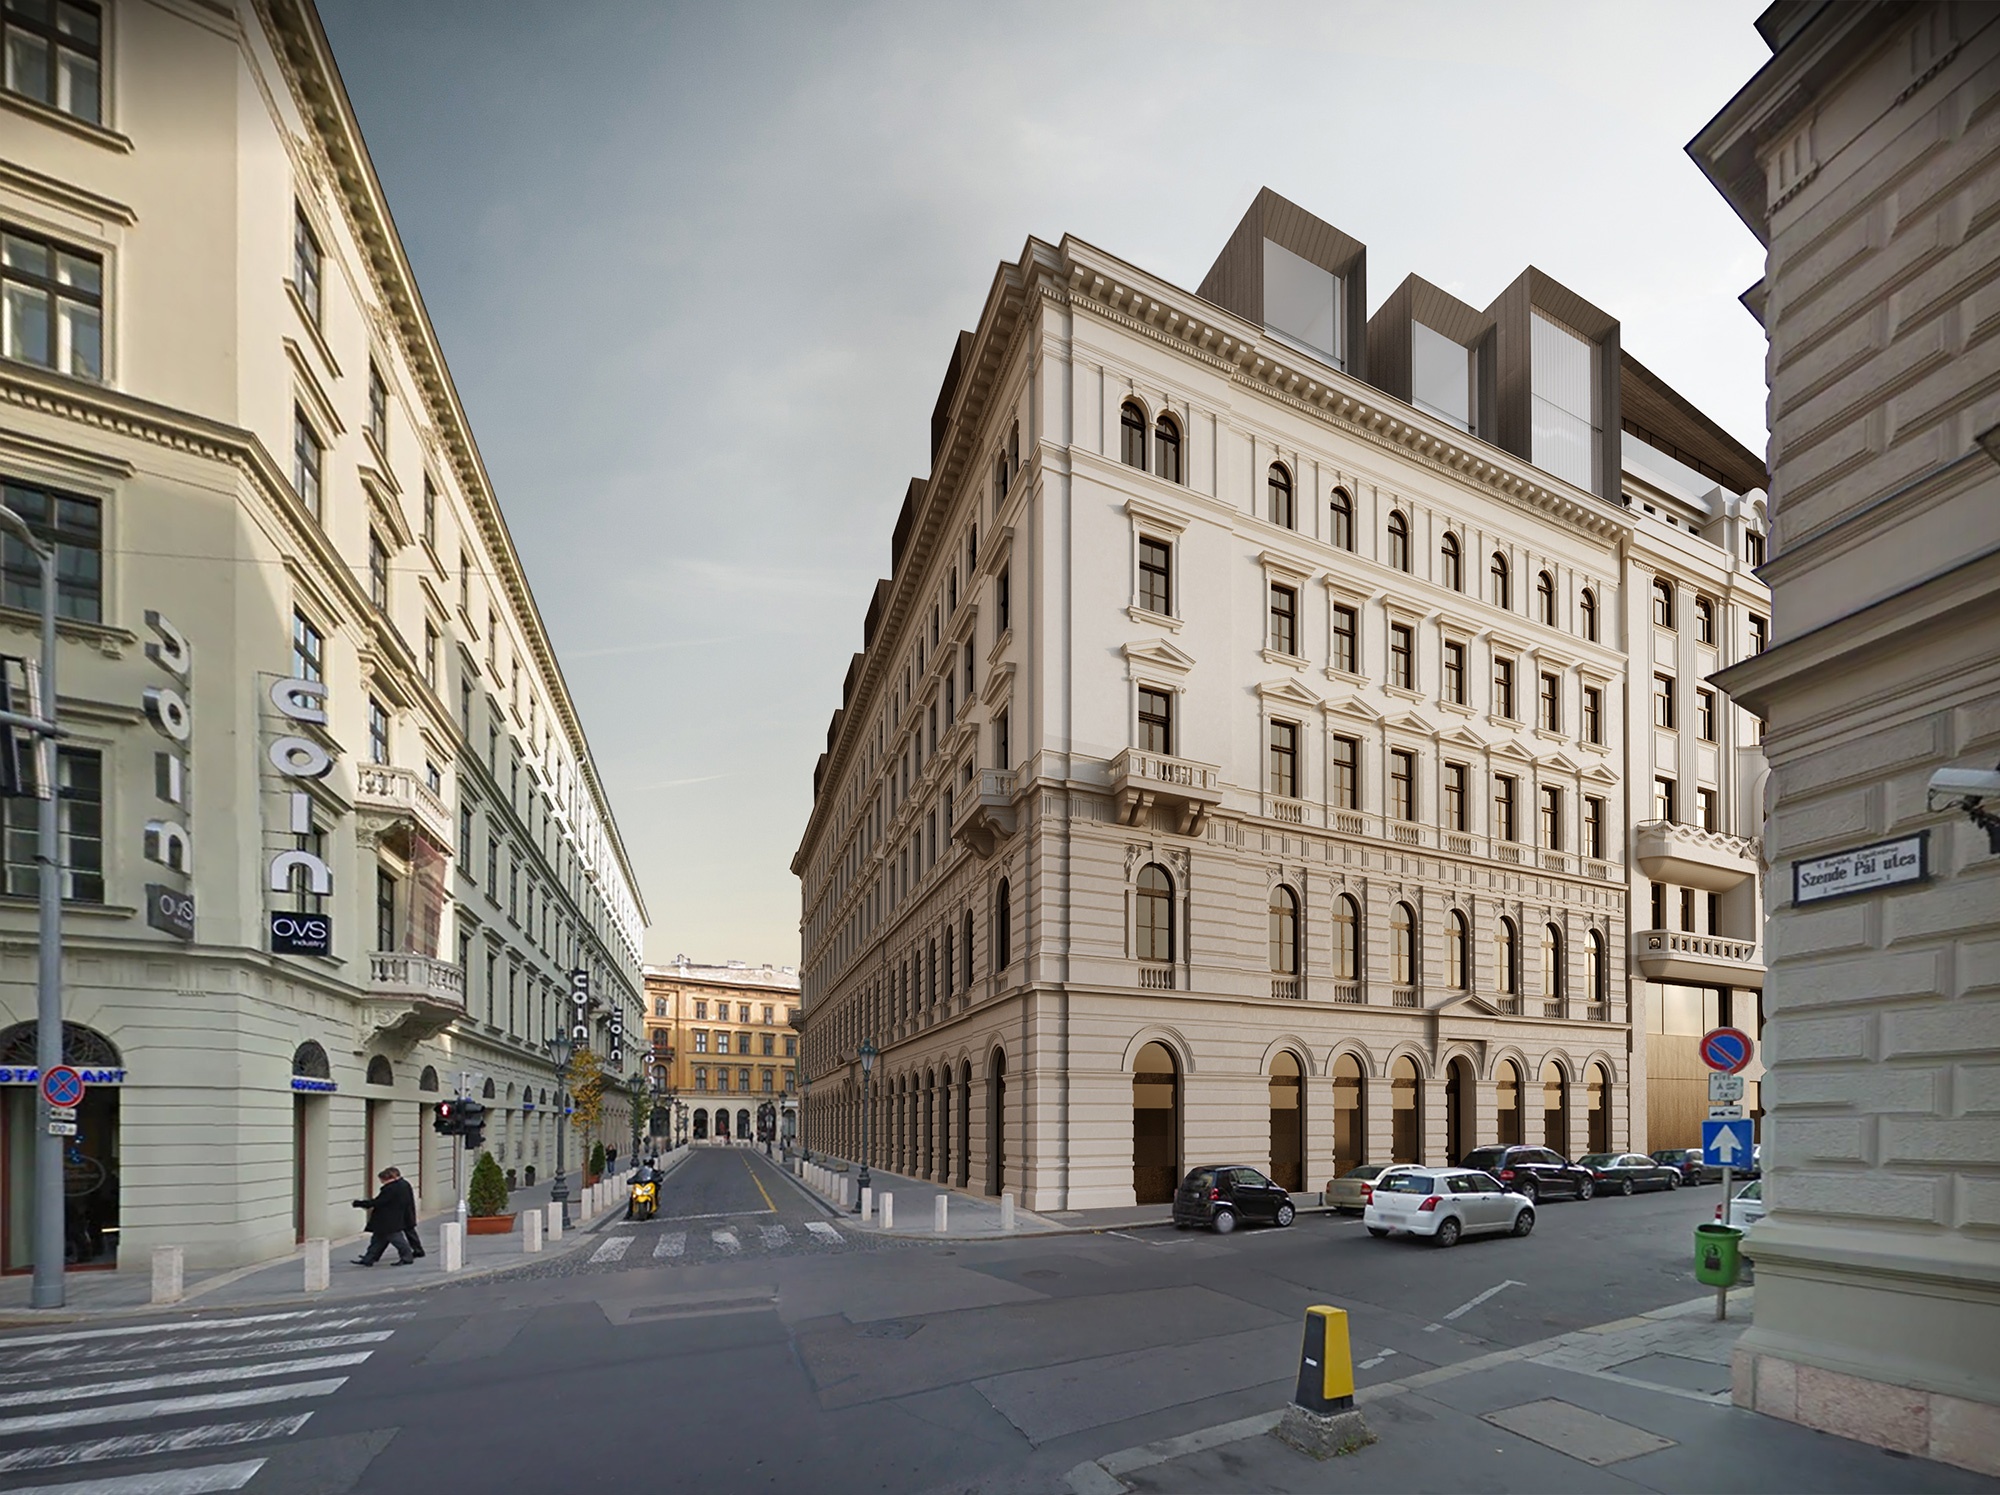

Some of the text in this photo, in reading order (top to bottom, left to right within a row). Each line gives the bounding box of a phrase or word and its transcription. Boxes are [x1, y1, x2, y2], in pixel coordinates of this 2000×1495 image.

[270, 678, 332, 896] coin
[1801, 852, 1916, 888] Szende Pál utca
[160, 894, 193, 920] OVS
[273, 918, 327, 939] OVS
[573, 974, 588, 1038] coin
